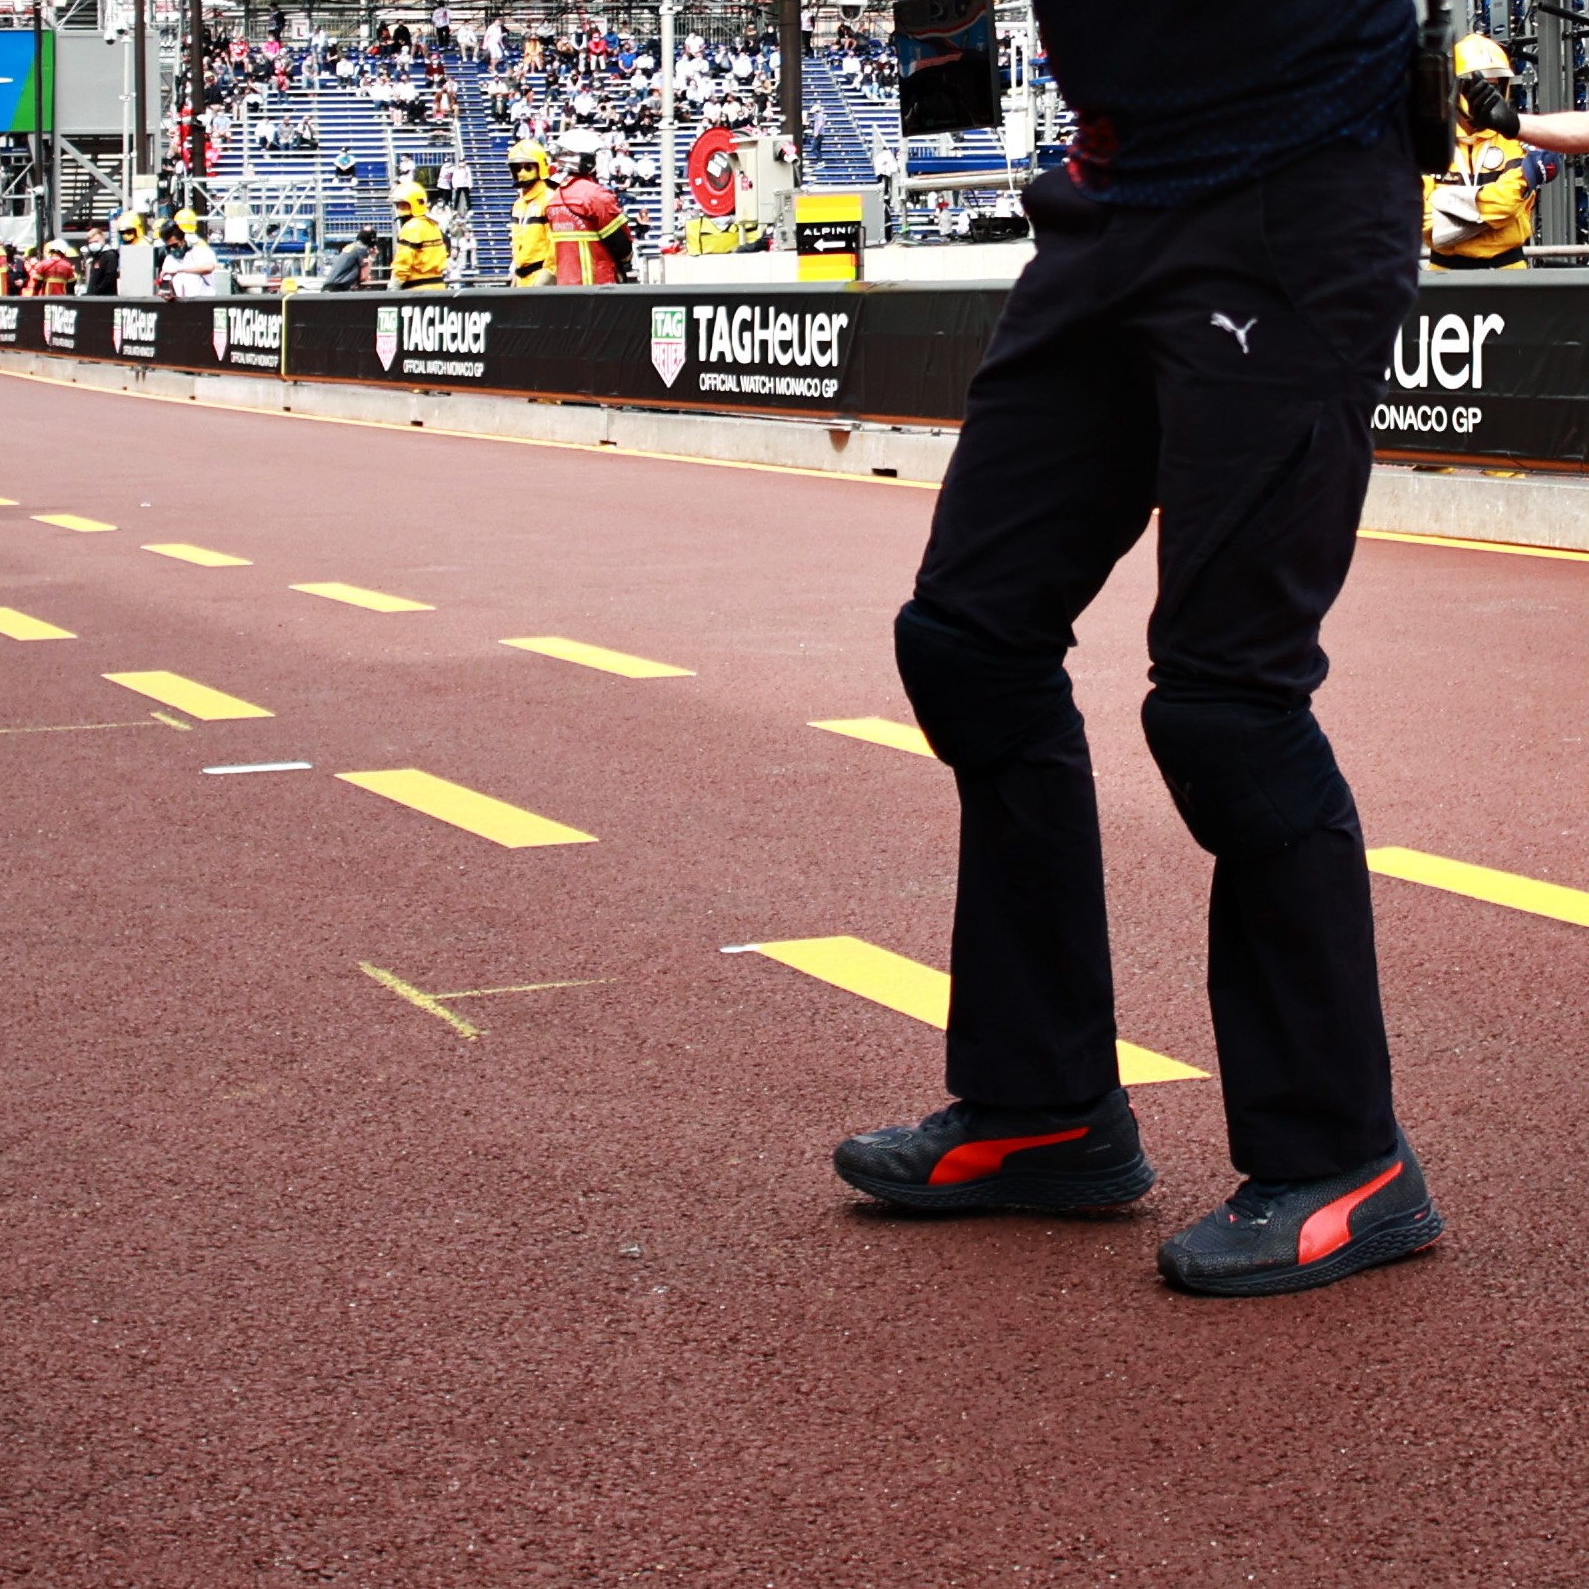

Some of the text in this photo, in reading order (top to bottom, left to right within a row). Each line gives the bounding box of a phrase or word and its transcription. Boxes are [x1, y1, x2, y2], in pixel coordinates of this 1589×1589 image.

[655, 313, 682, 338] TAG
[699, 373, 839, 398] OFFICIAL WATCH MONACO GP
[1452, 406, 1482, 433] GP
